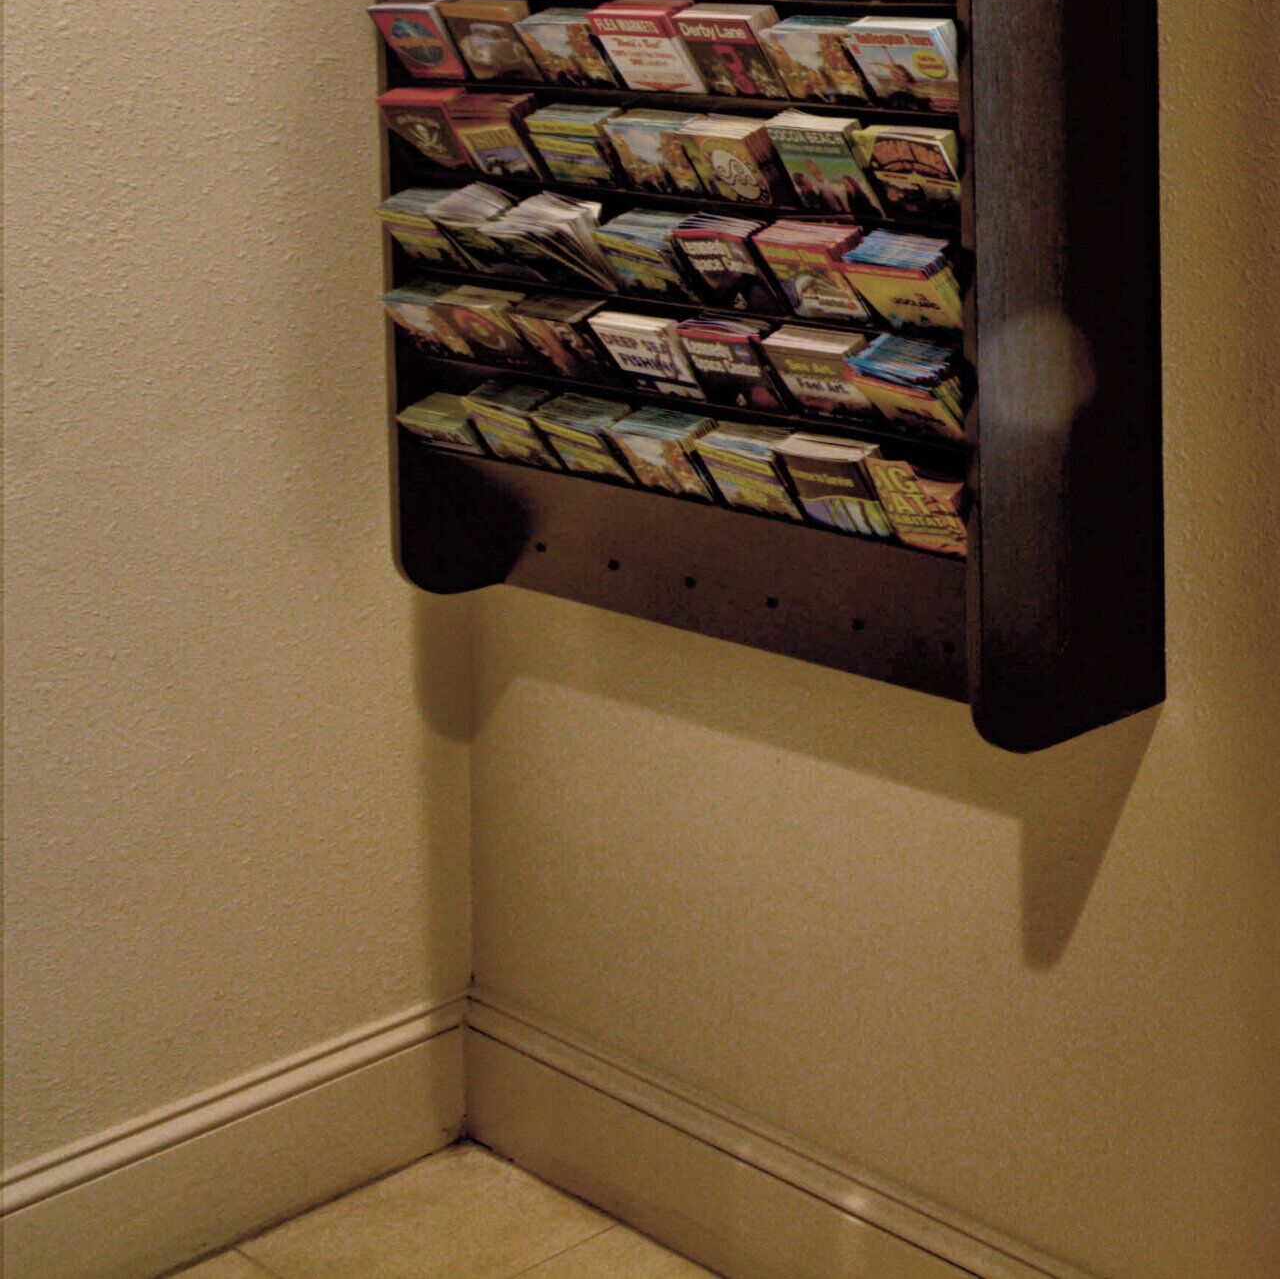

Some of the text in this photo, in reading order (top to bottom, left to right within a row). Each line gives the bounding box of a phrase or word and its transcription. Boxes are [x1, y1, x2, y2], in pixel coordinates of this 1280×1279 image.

[677, 21, 748, 41] Derby Lane
[602, 332, 638, 350] DEEP
